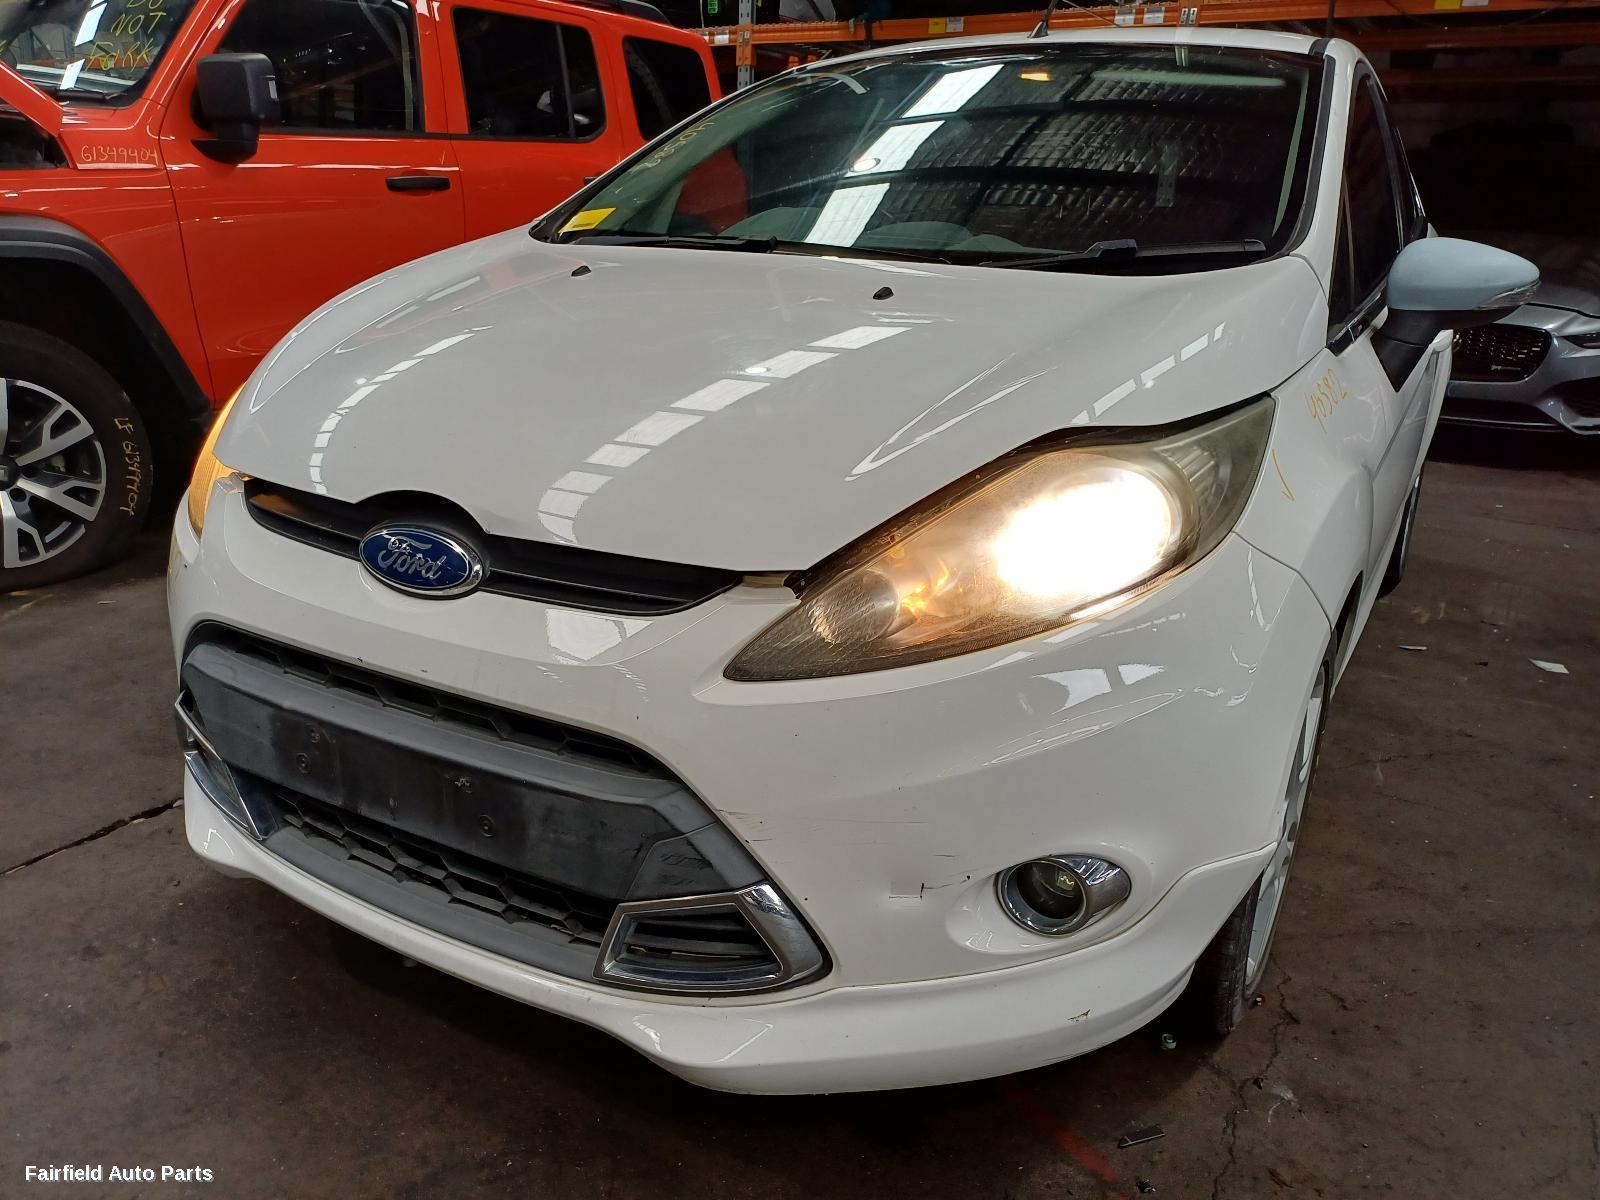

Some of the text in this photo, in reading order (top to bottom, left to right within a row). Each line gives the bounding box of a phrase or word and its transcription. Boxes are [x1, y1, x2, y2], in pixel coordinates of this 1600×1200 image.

[110, 12, 167, 37] NOT
[114, 417, 134, 436] LF
[377, 533, 447, 580] Ford
